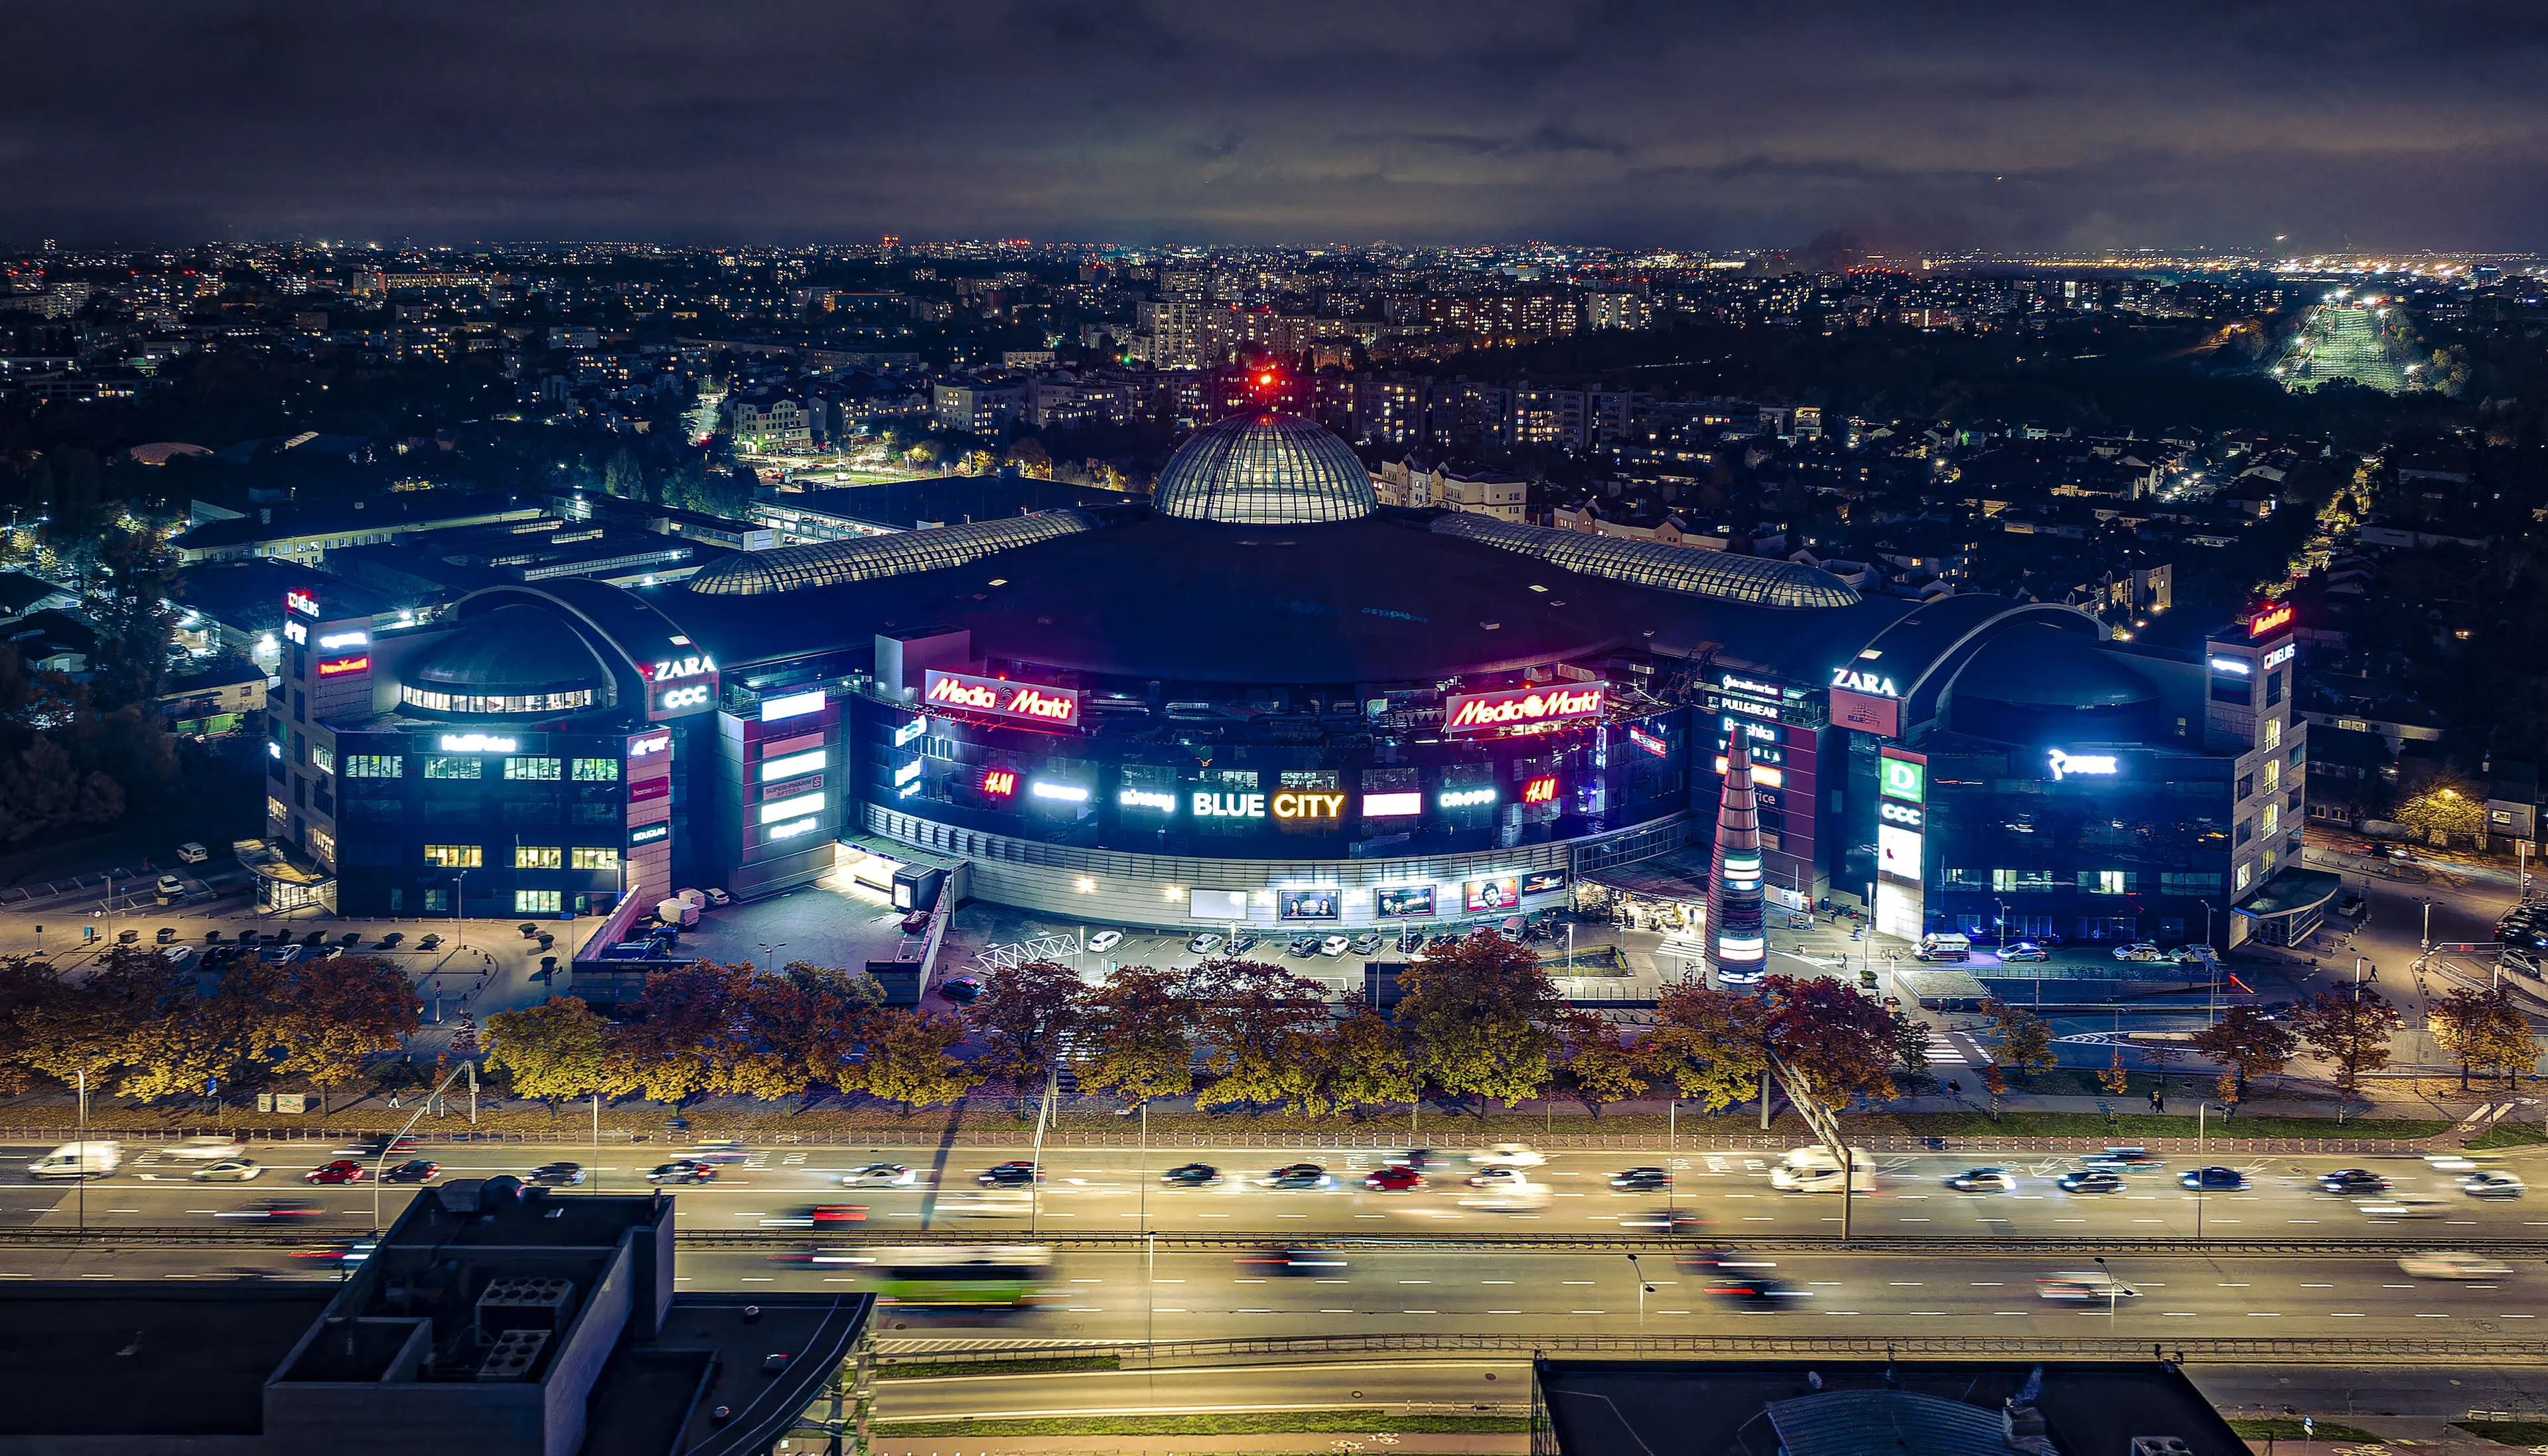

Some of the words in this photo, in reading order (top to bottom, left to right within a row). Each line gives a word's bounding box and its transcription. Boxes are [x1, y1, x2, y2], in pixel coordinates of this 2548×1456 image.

[655, 655, 717, 681] ZARA
[1832, 667, 1898, 696] ZARA
[664, 685, 708, 708] CCC
[928, 677, 996, 708] Media
[1007, 689, 1072, 720] Markt
[1452, 700, 1524, 727] Media
[1540, 691, 1601, 717] Markt
[1890, 763, 1915, 789] D
[1193, 792, 1265, 817] BLUE
[1273, 793, 1346, 819] CITY
[1882, 803, 1921, 825] CCC
